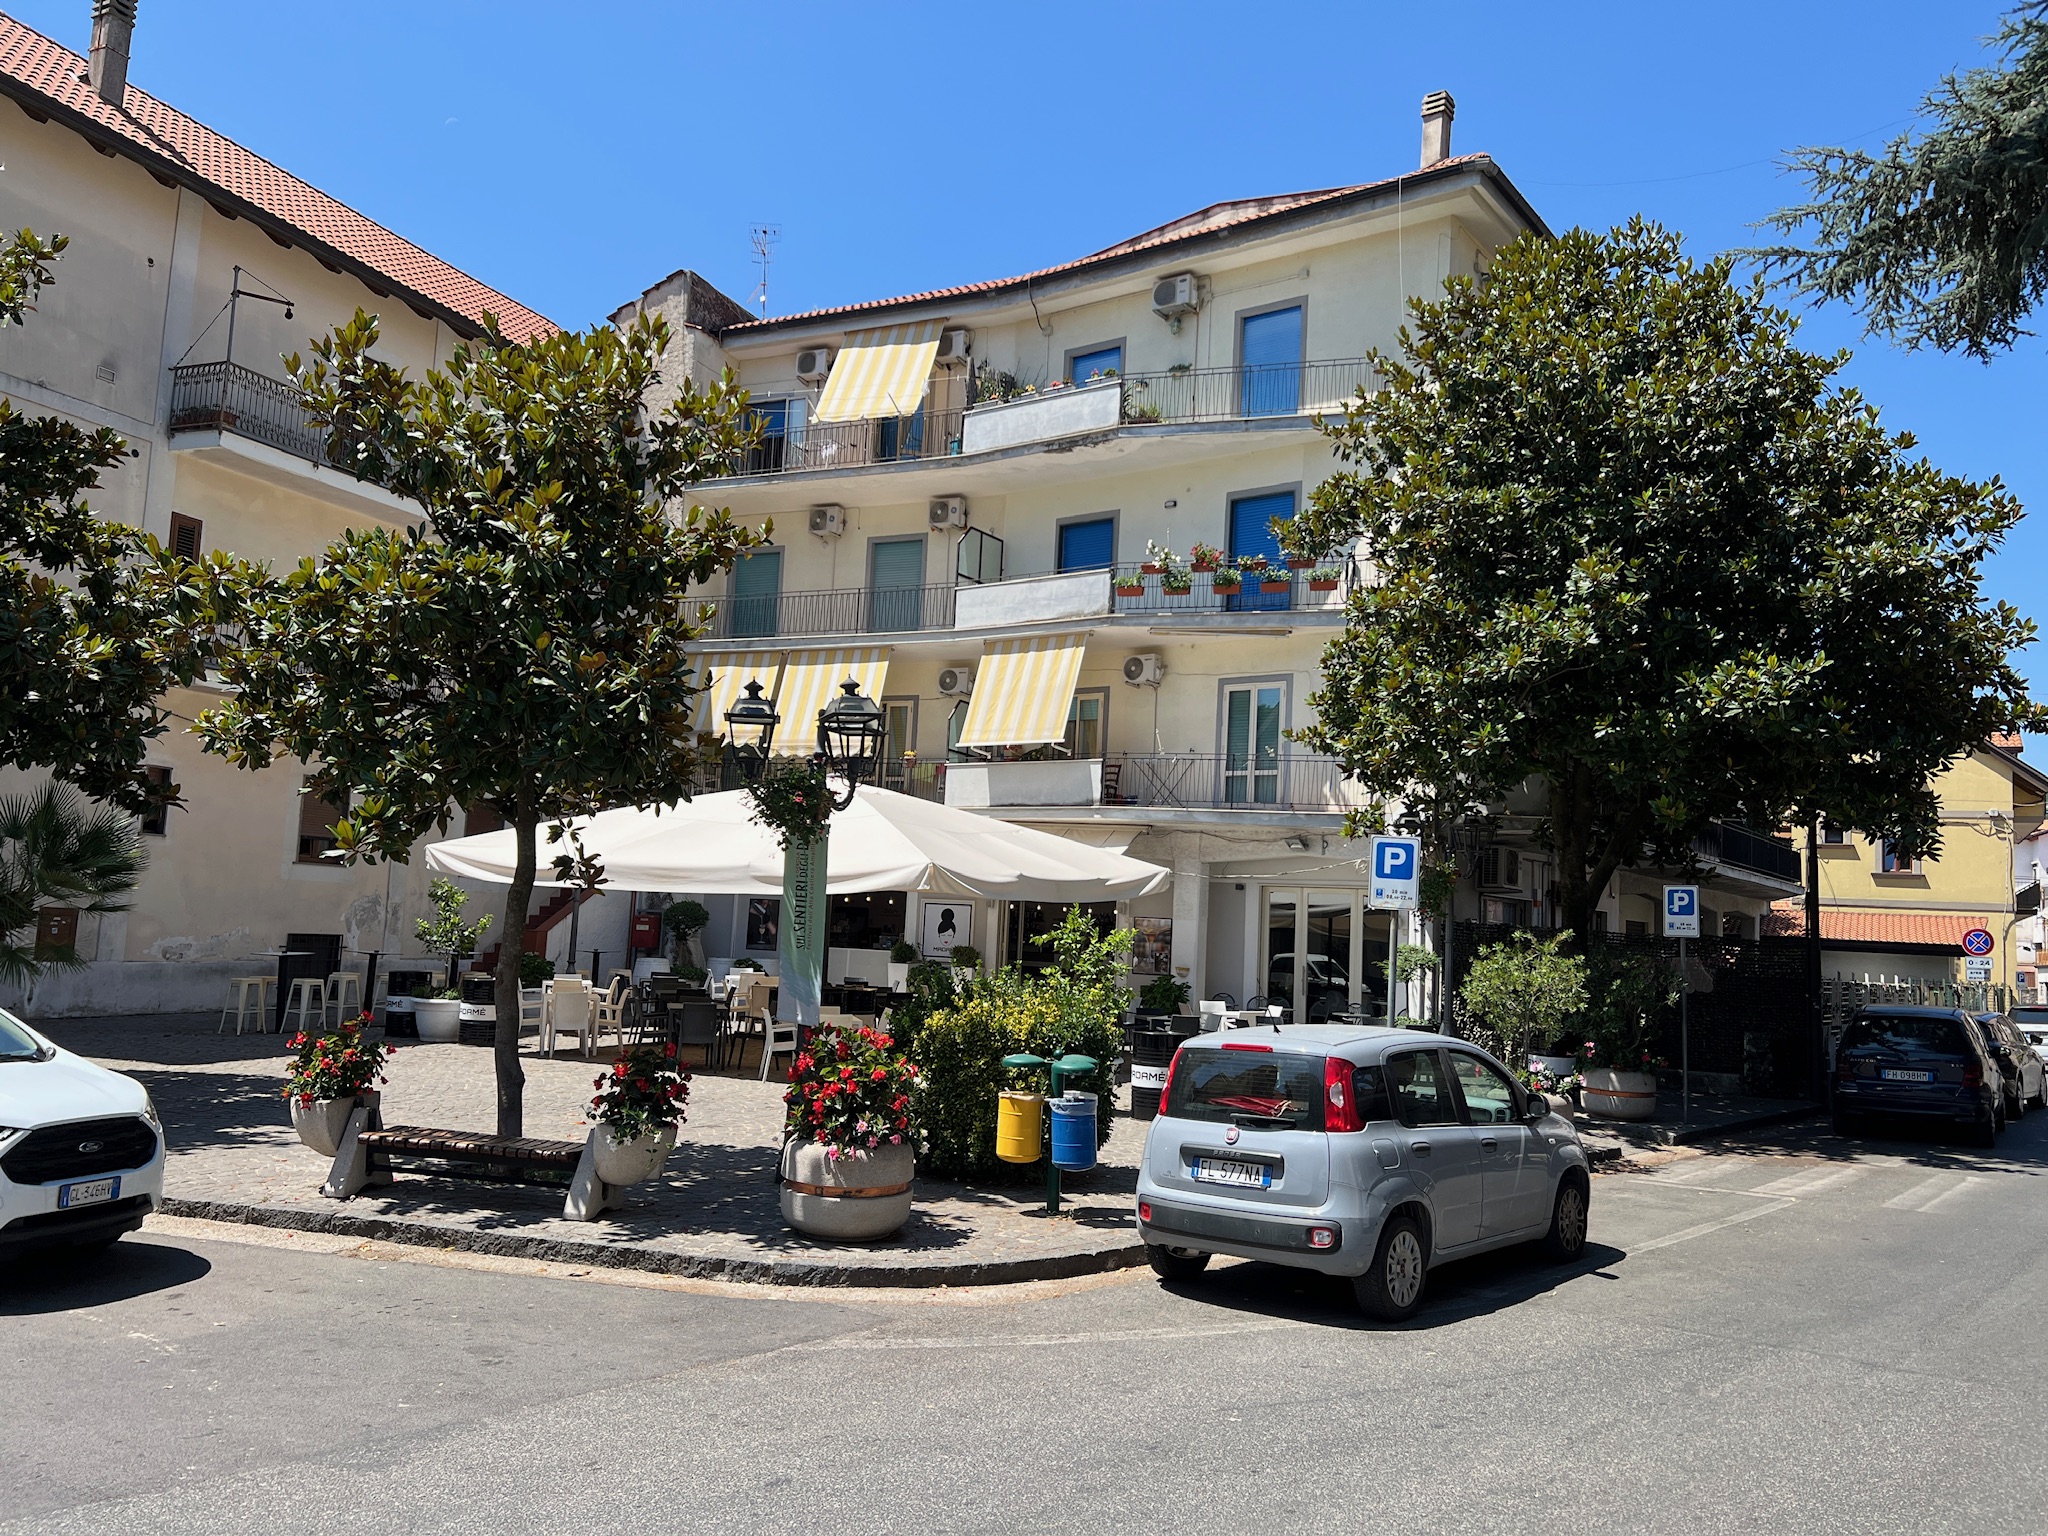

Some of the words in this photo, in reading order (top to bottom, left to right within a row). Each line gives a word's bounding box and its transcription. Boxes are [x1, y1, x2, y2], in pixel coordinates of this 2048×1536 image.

[1383, 846, 1407, 874] P
[793, 880, 808, 933] SENTIERI
[1673, 892, 1690, 913] P
[1200, 1160, 1214, 1178] FL
[1220, 1162, 1261, 1183] 577NA
